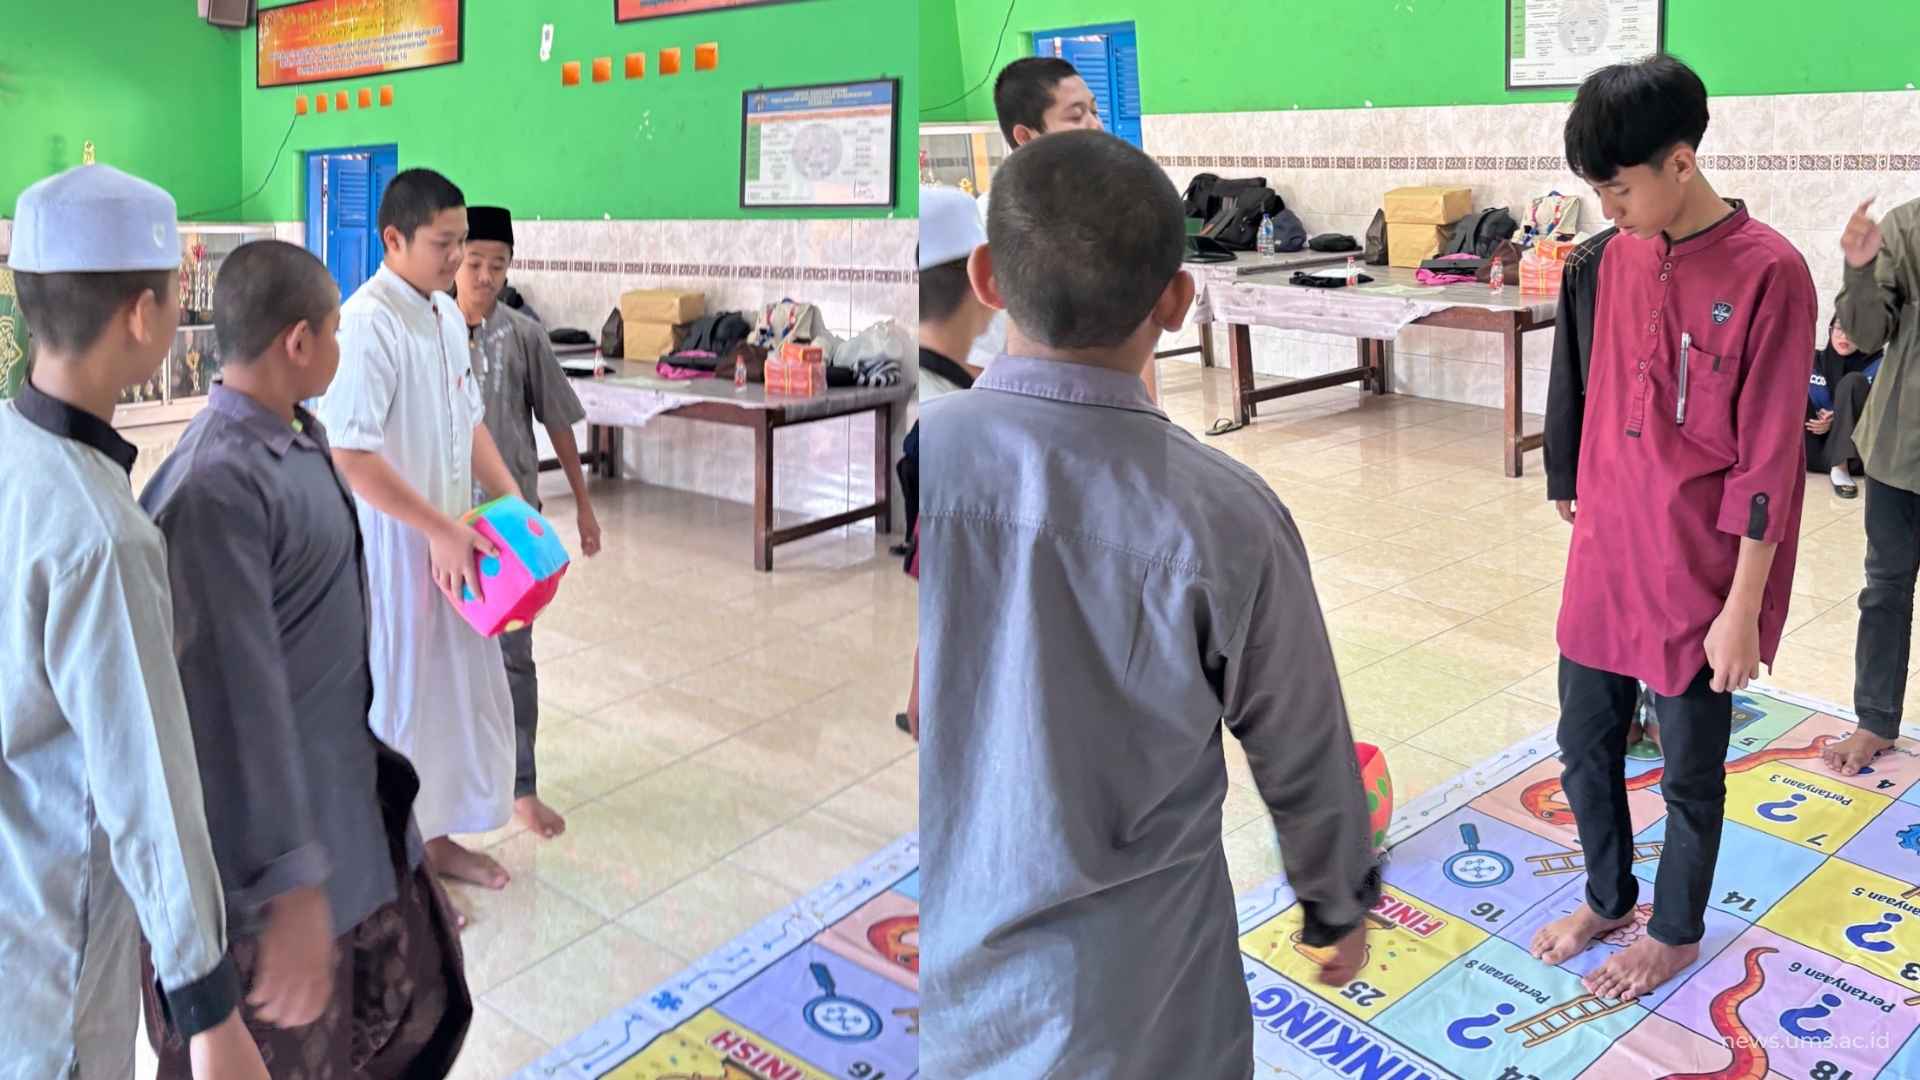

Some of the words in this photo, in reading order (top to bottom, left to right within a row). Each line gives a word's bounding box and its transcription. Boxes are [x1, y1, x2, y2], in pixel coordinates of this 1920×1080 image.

[1769, 774, 1781, 783] 3
[1877, 779, 1896, 790] 4
[1782, 776, 1853, 806] Pertanyaan
[1806, 834, 1829, 847] 7
[1721, 890, 1757, 912] 14
[1851, 887, 1866, 897] 5
[1470, 902, 1505, 923] 16
[1867, 891, 1920, 917] anyaan
[1374, 894, 1445, 937] FINIS
[1464, 959, 1480, 969] 8
[1788, 961, 1802, 973] 6
[1900, 962, 1920, 981] 3
[1340, 981, 1388, 1007] 25
[1479, 962, 1552, 1005] Pertanyaan
[1804, 967, 1897, 1013] Pertanyaan
[1251, 986, 1432, 1080] INKING
[710, 1030, 803, 1080] INISH
